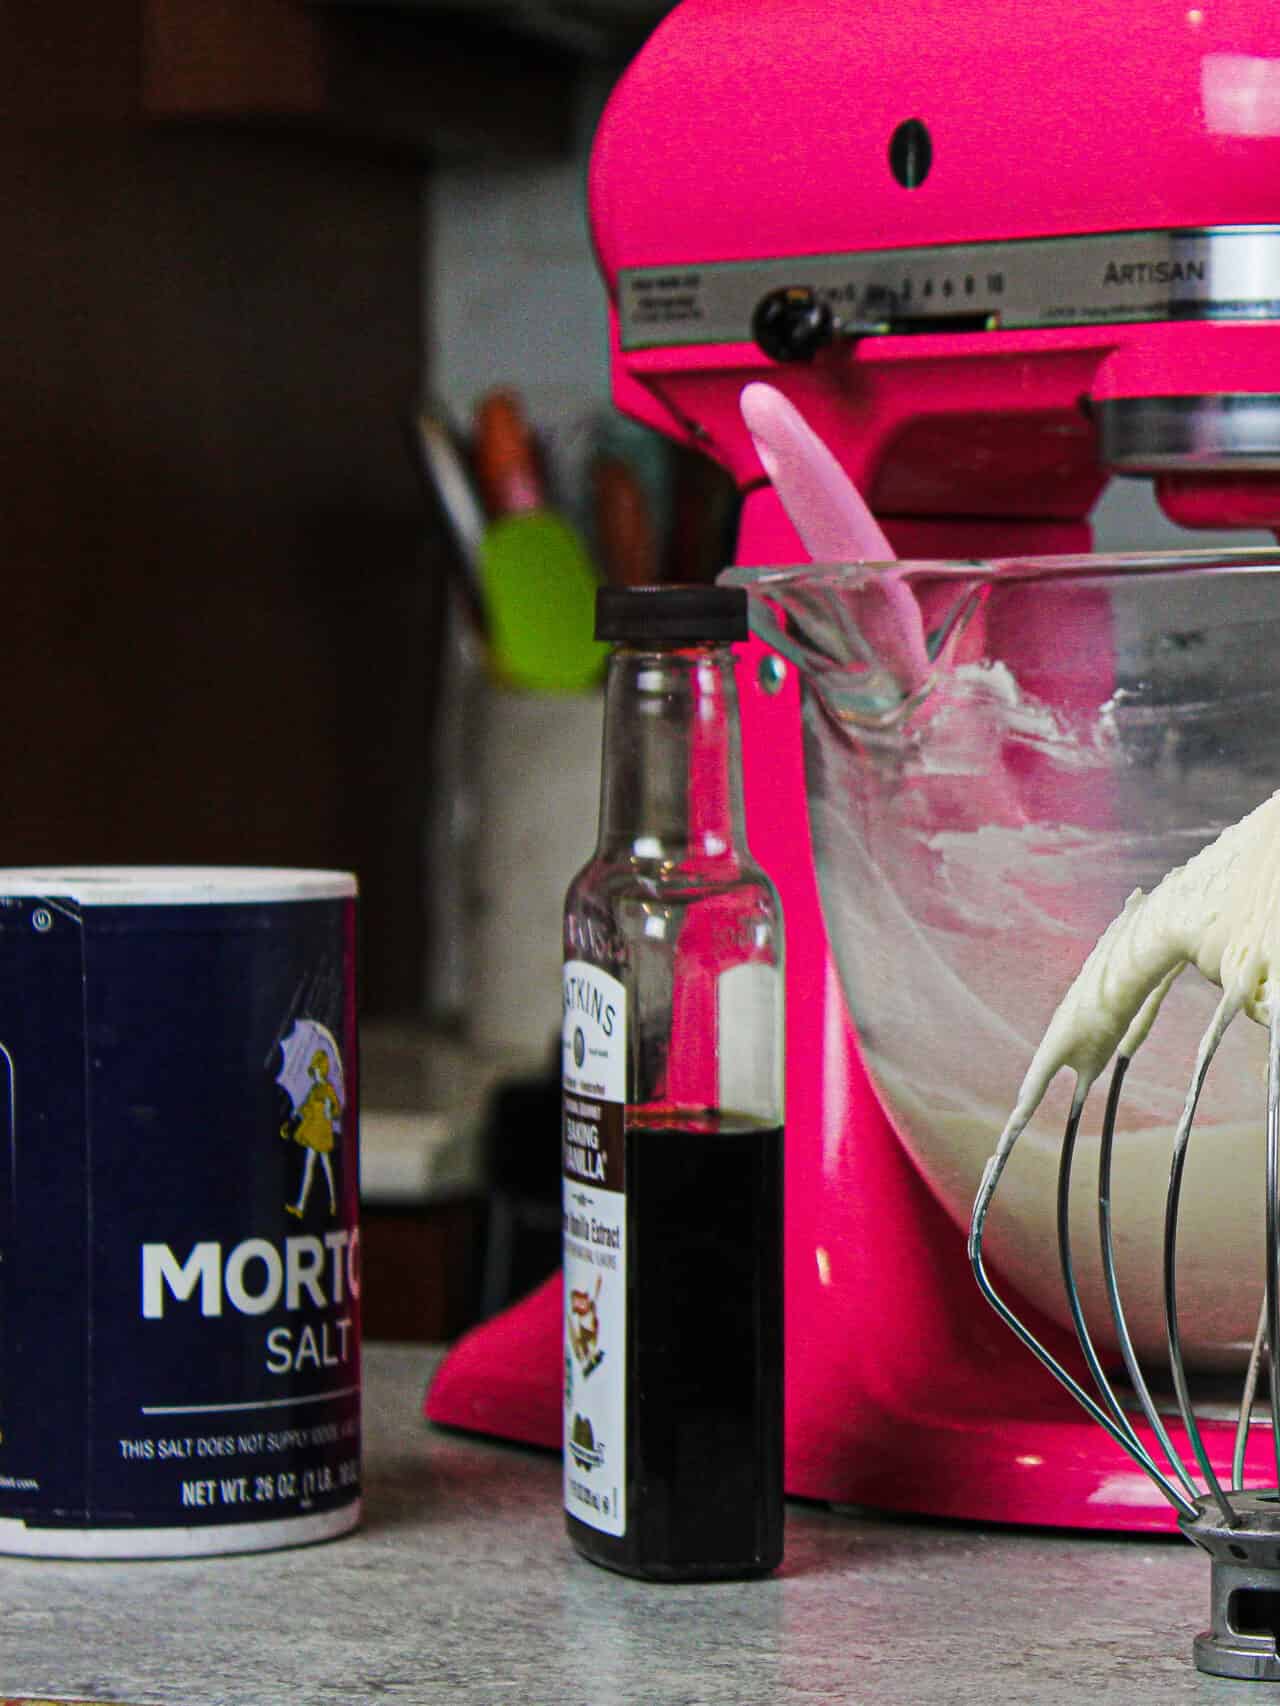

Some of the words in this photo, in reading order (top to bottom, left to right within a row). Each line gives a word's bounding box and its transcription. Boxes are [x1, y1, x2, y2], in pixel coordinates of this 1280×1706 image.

[1104, 259, 1205, 287] ARTISAN
[266, 1318, 352, 1374] SALT
[119, 1440, 153, 1459] THIS
[157, 1438, 193, 1459] SALT
[197, 1437, 234, 1457] DOES
[238, 1433, 263, 1454] NOT
[181, 1480, 216, 1506] NET
[221, 1478, 251, 1504] WT.
